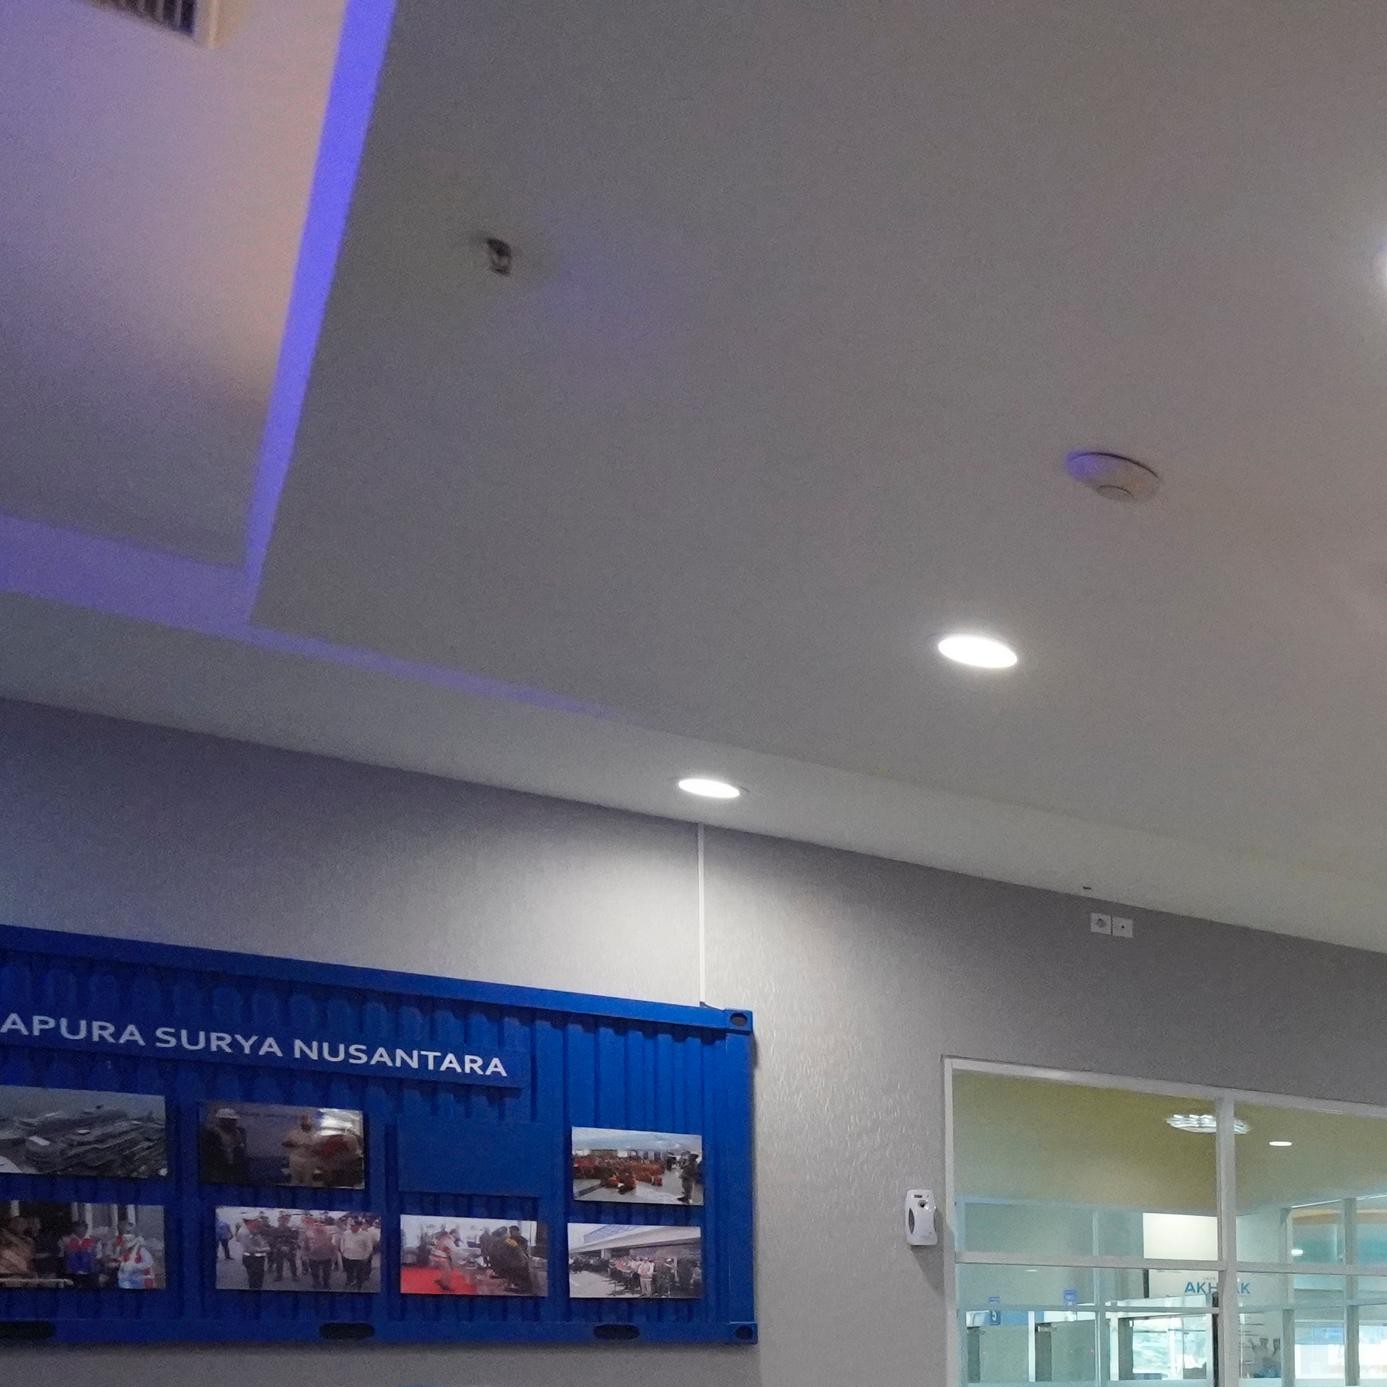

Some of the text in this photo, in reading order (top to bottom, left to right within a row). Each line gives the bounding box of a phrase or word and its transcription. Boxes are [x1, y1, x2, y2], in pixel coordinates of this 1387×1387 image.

[1, 1012, 508, 1077] APURA SURYA NUSANTARA
[1185, 1282, 1250, 1294] AKHK
